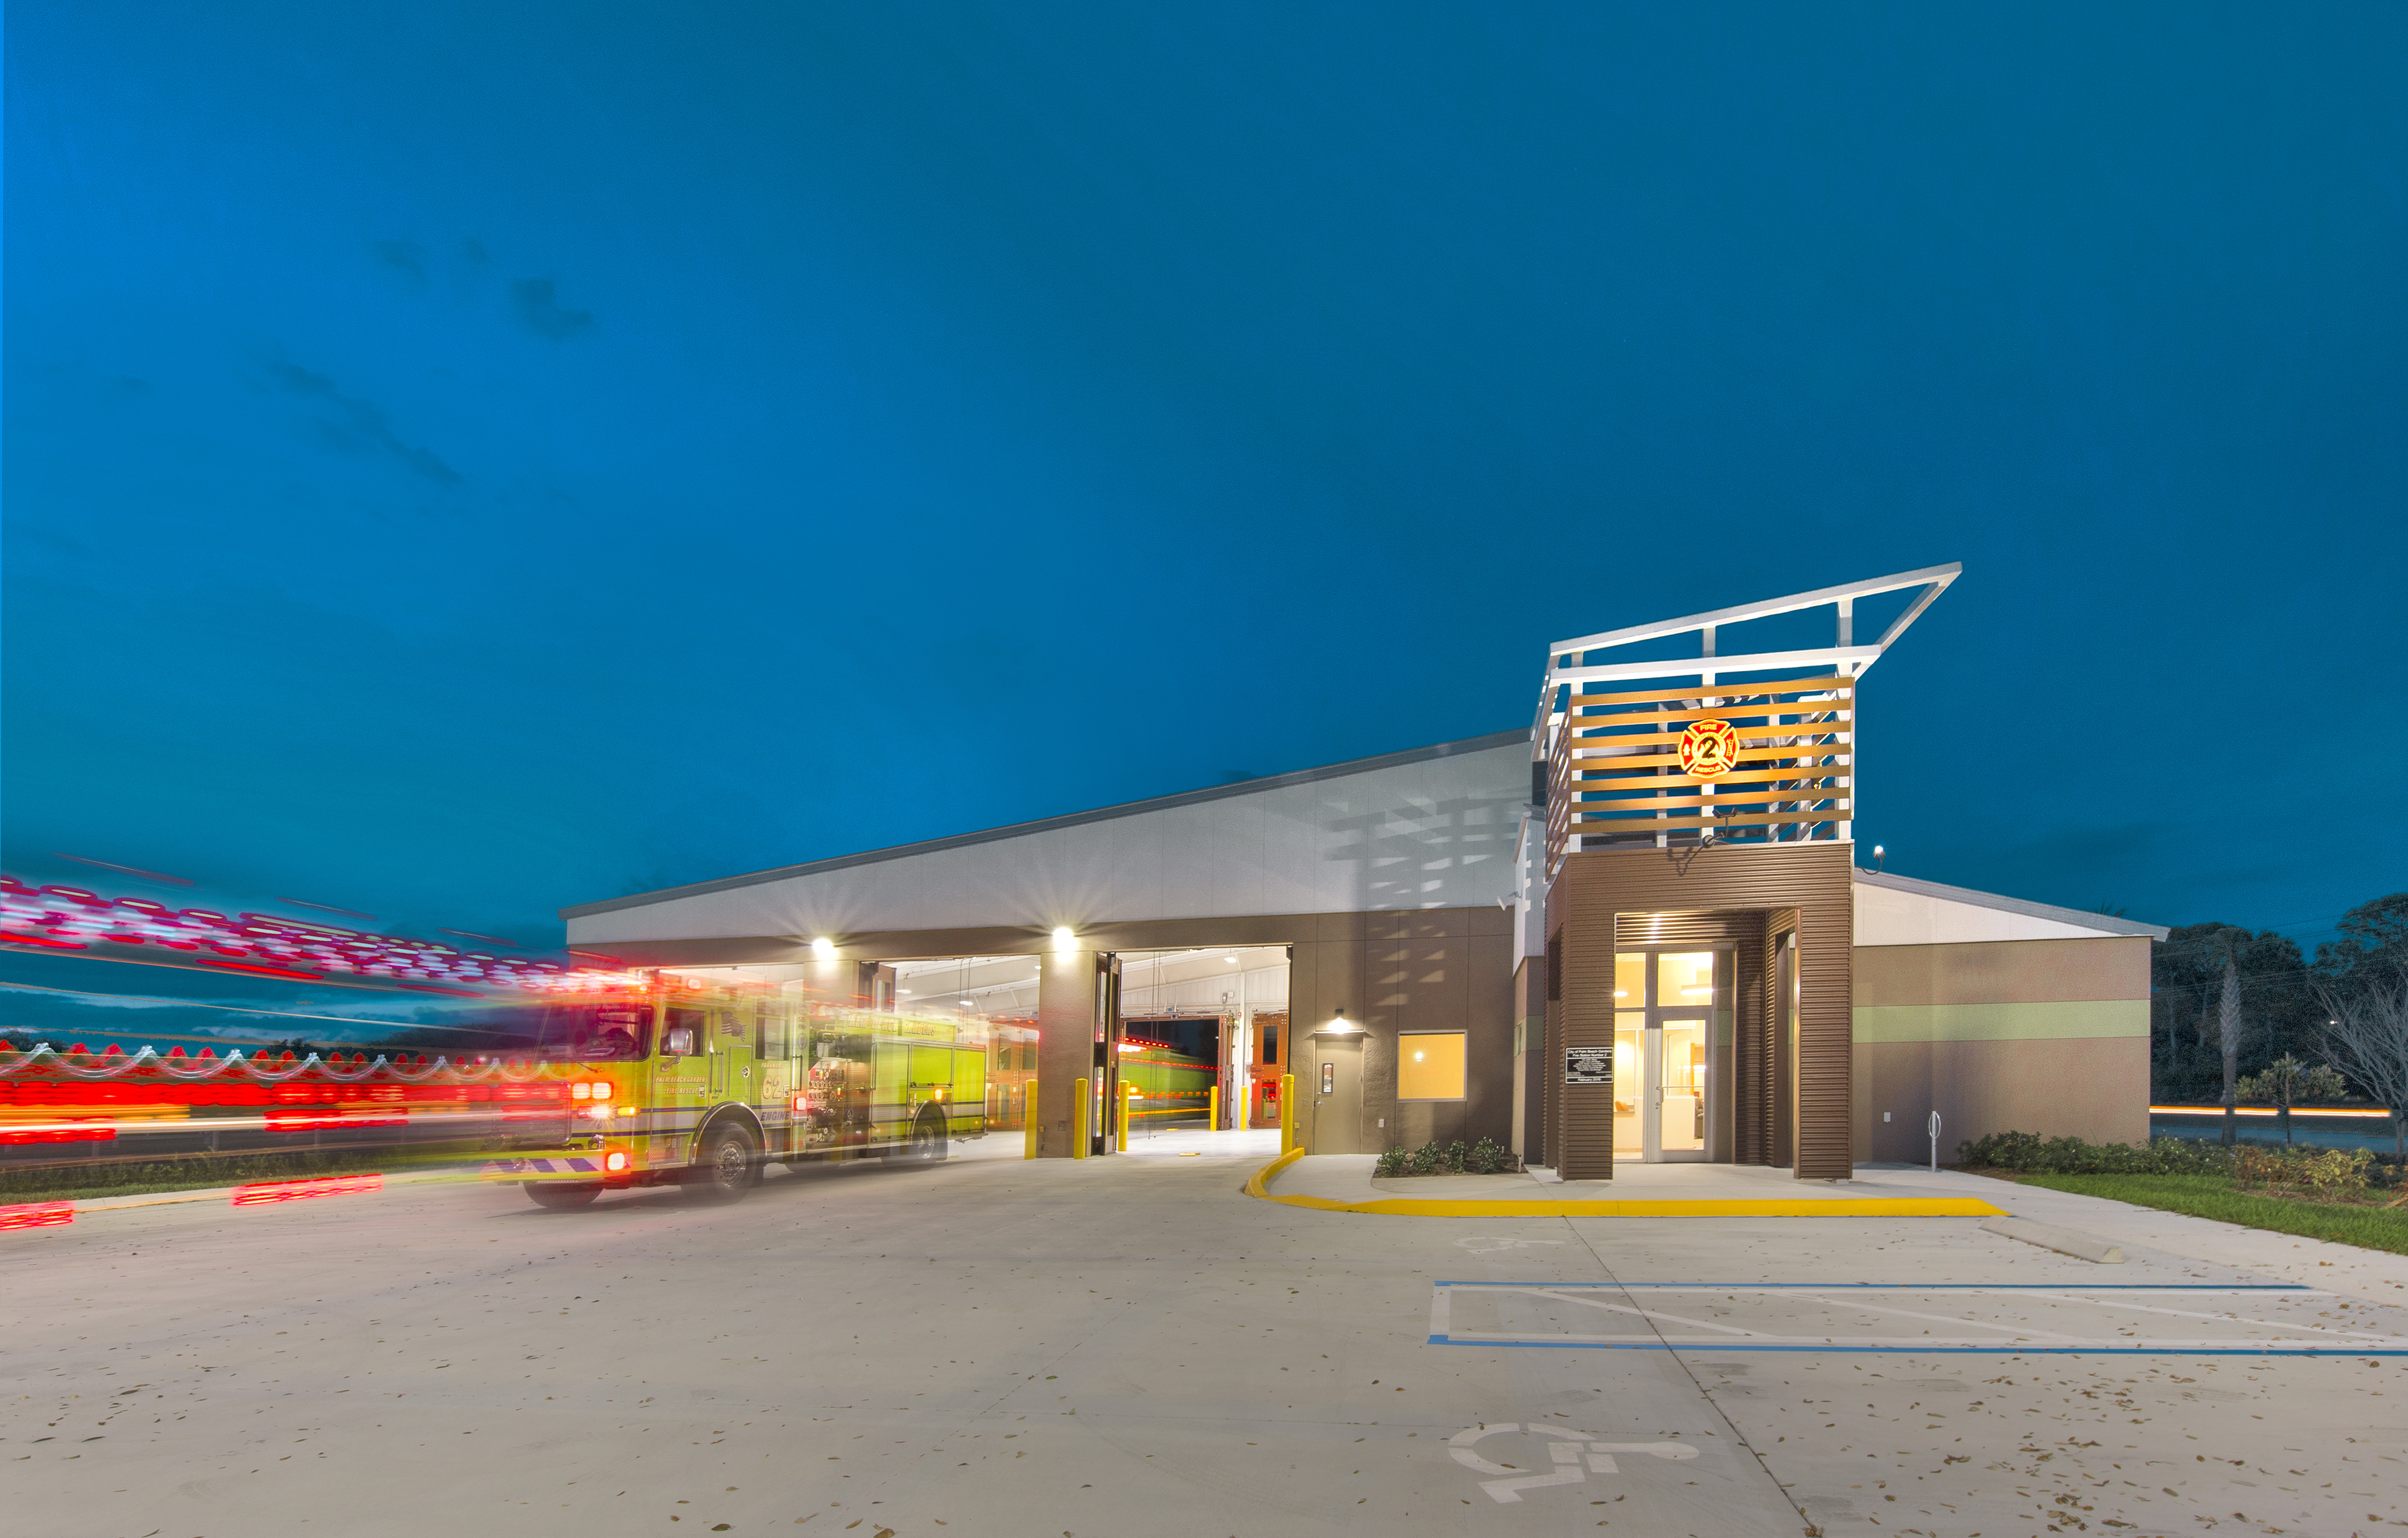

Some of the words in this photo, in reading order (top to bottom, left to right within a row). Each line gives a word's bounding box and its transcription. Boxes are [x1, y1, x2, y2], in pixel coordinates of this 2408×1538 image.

[1708, 733, 1724, 745] BEACH
[1702, 737, 1716, 758] 2
[762, 1075, 782, 1099] 62
[760, 1111, 790, 1121] ENGINE
